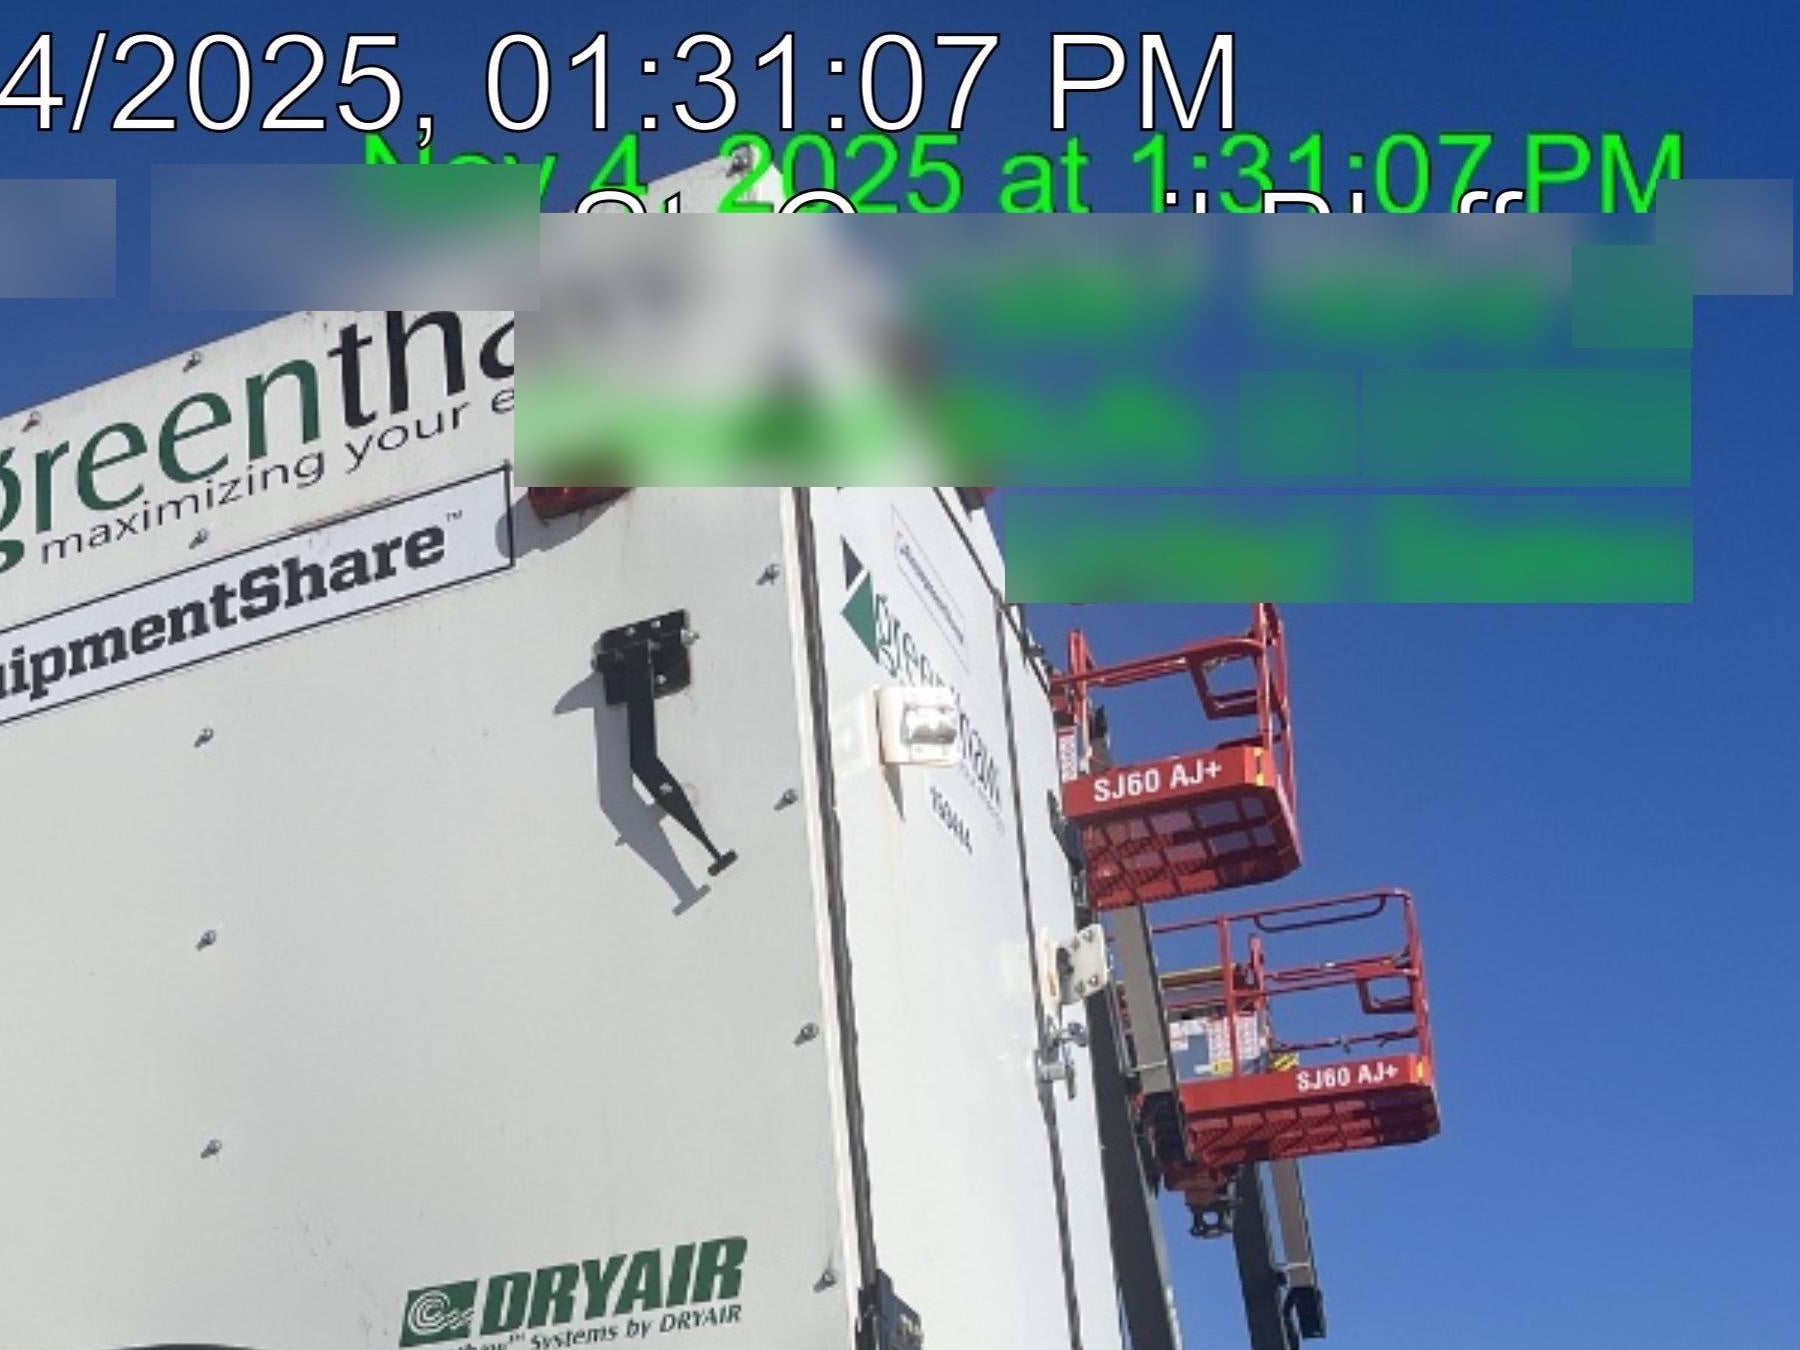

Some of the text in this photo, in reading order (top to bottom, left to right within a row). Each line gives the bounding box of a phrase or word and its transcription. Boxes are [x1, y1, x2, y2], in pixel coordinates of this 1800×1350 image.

[40, 402, 471, 566] maximizing your
[1093, 758, 1223, 803] SJ60 AJ+
[1295, 1060, 1399, 1093] SJ60 AJ+
[480, 1235, 748, 1337] DRYAIR
[625, 1318, 653, 1340] by
[659, 1304, 743, 1334] DRYAIR
